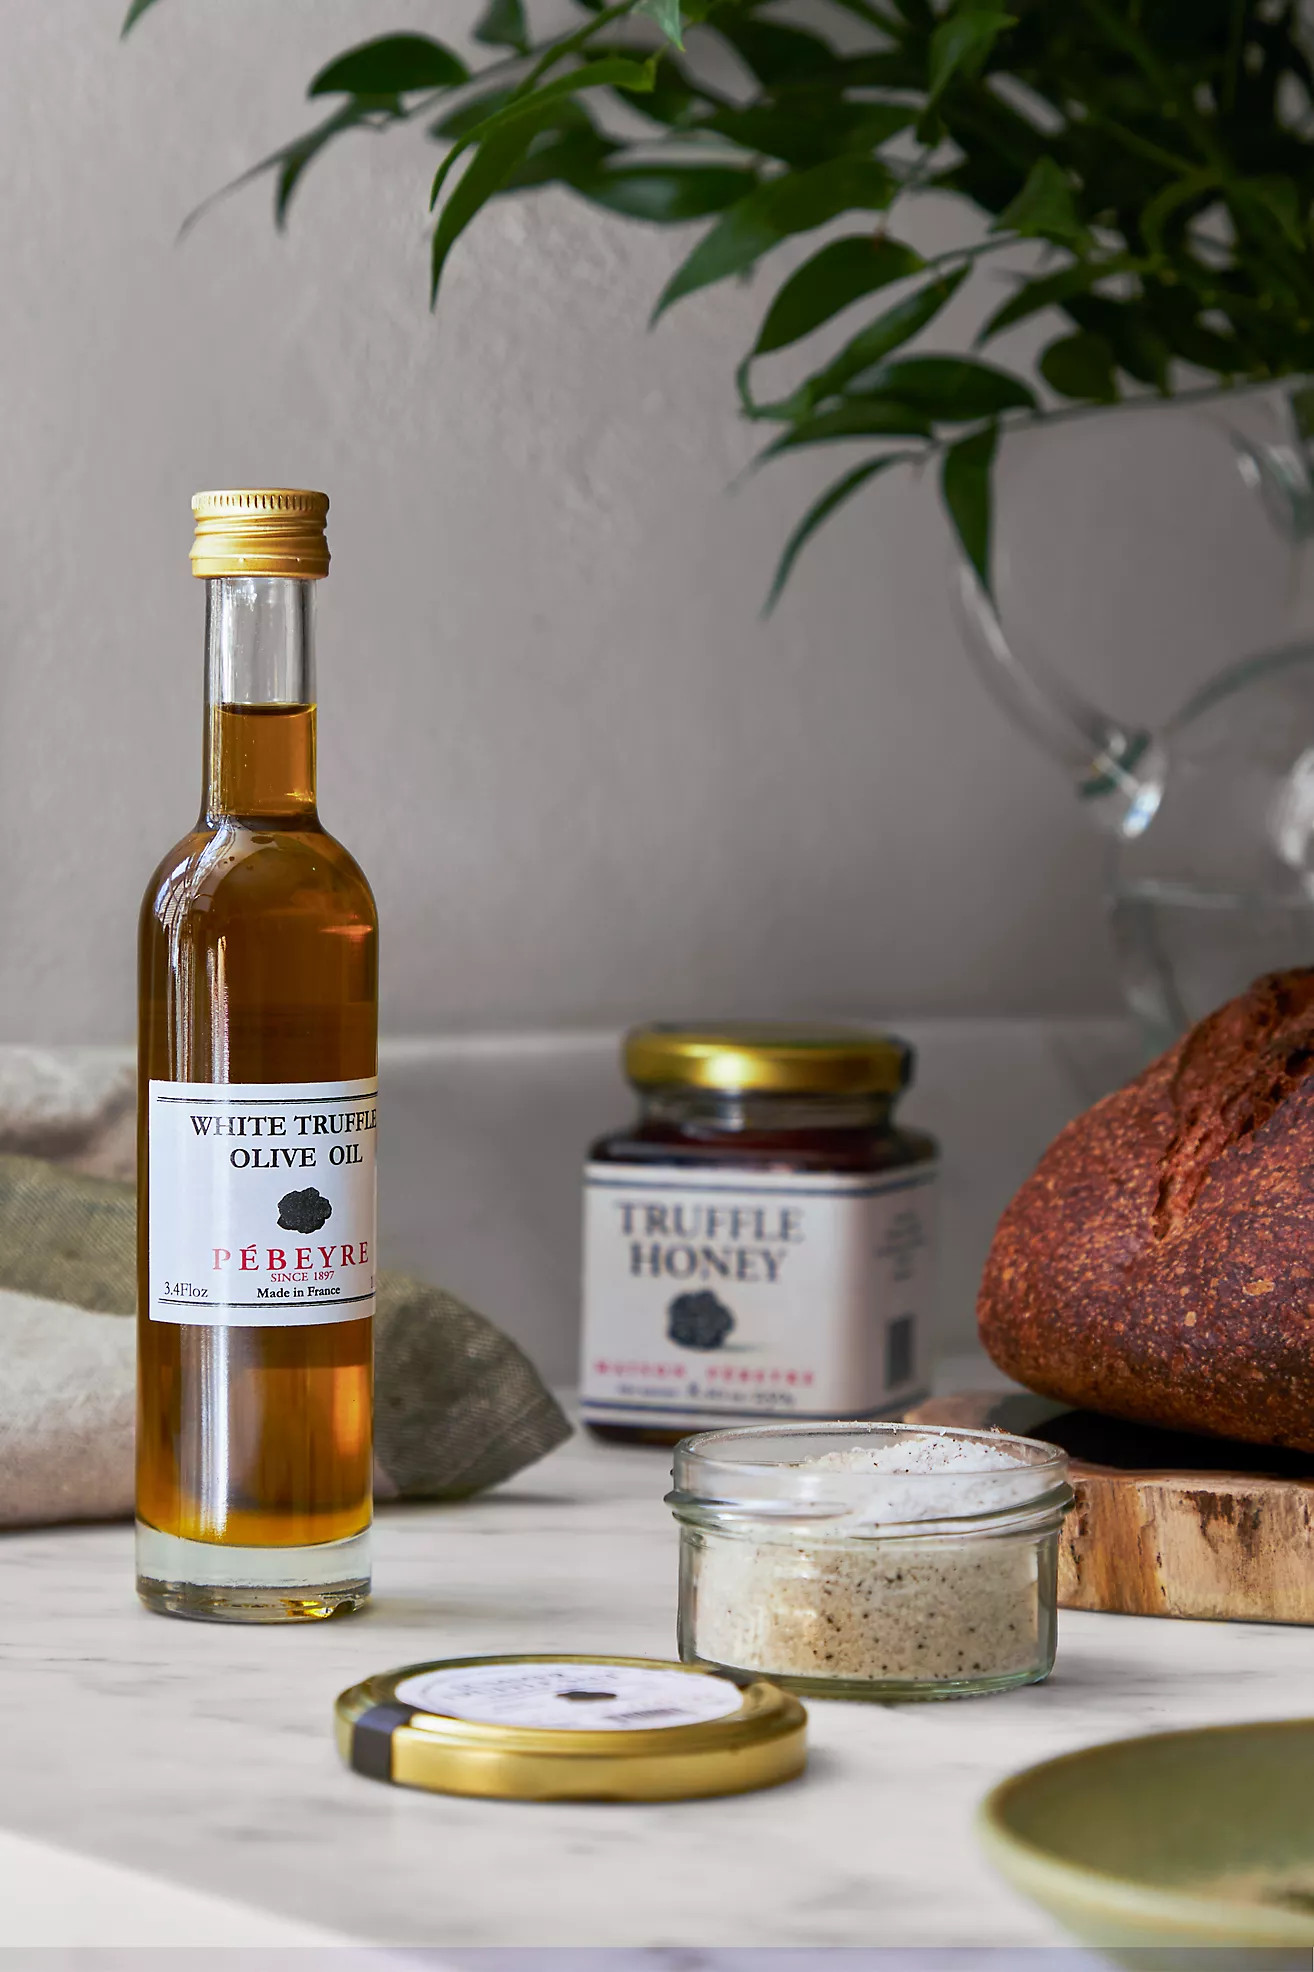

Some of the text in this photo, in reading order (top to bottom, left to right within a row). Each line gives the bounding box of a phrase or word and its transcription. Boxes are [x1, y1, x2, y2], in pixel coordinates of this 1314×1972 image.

[190, 1108, 377, 1137] WHITE TRUFFLE
[230, 1143, 364, 1169] OLIVE OIL
[616, 1201, 805, 1243] TRUFFLE
[212, 1241, 369, 1271] PÉBEYRE
[629, 1241, 787, 1283] HONEY
[270, 1270, 335, 1283] SINCE 1897
[256, 1286, 341, 1299] Made in France
